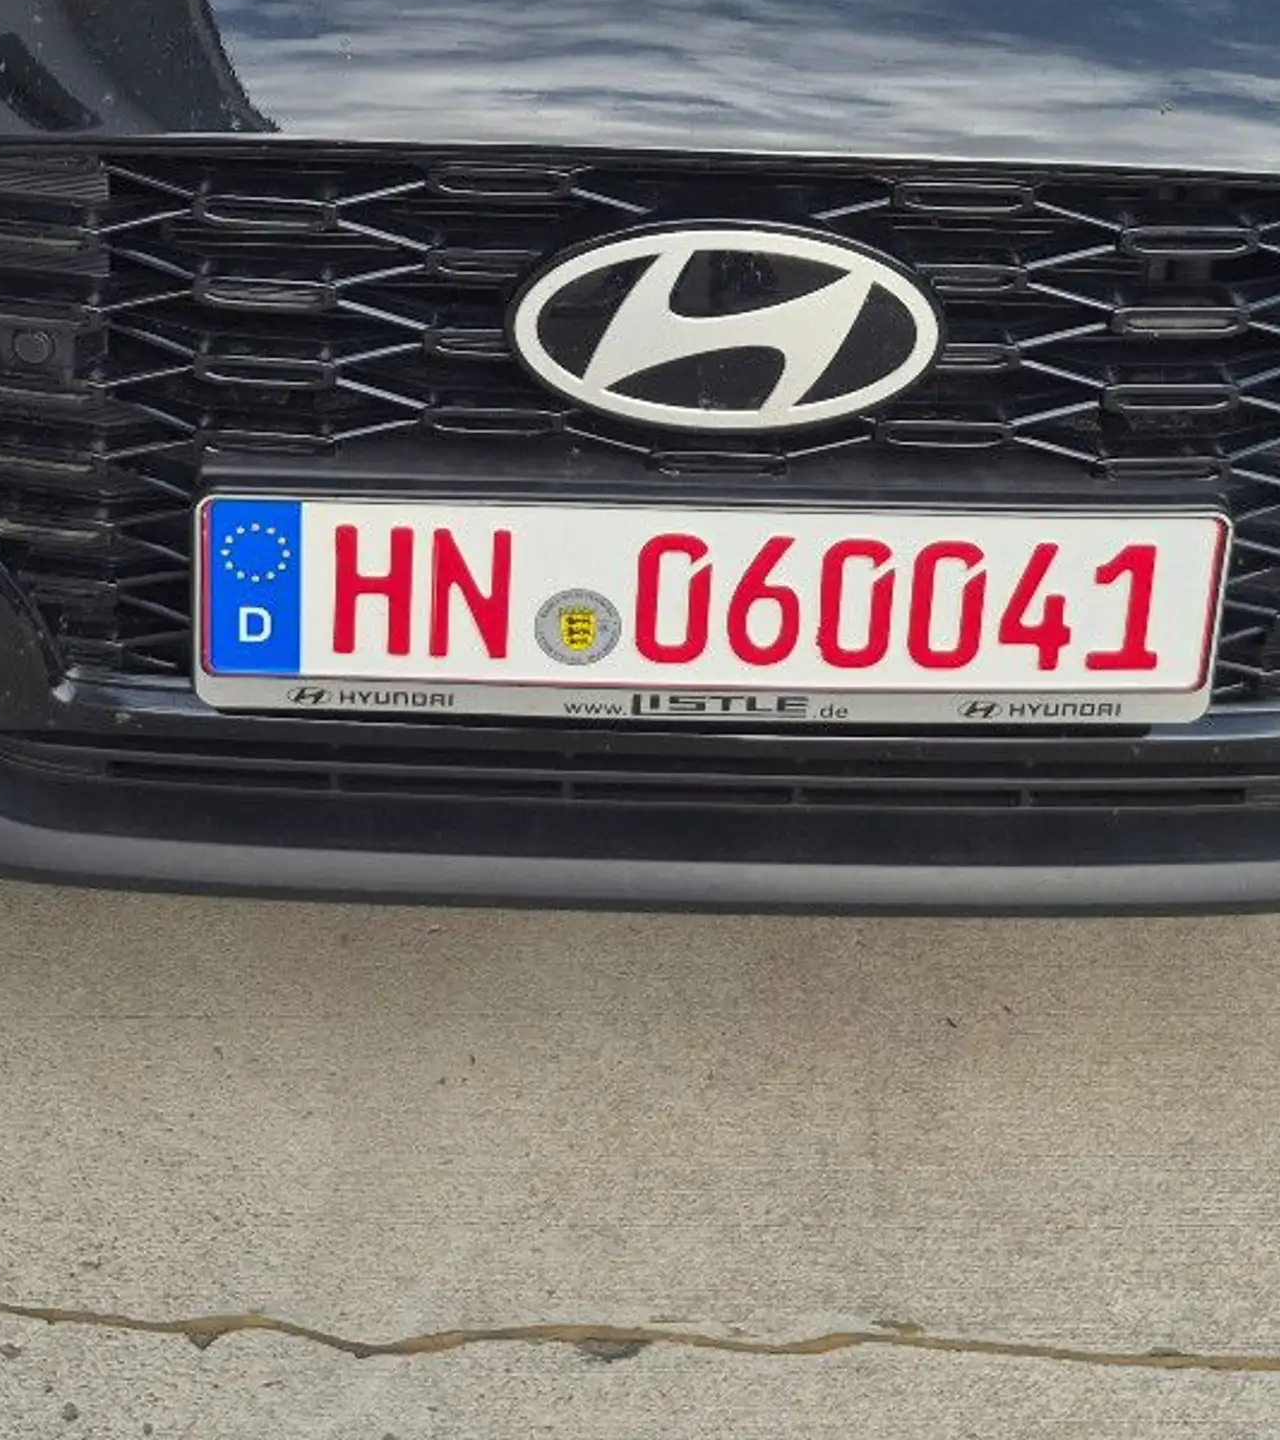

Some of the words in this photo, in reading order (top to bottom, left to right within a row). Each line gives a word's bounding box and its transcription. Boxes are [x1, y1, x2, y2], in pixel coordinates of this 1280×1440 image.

[332, 524, 512, 659] HN
[635, 533, 1158, 670] 060041
[238, 606, 272, 643] D
[338, 690, 455, 708] HYUNDAI
[1008, 702, 1122, 718] HYUNDAI
